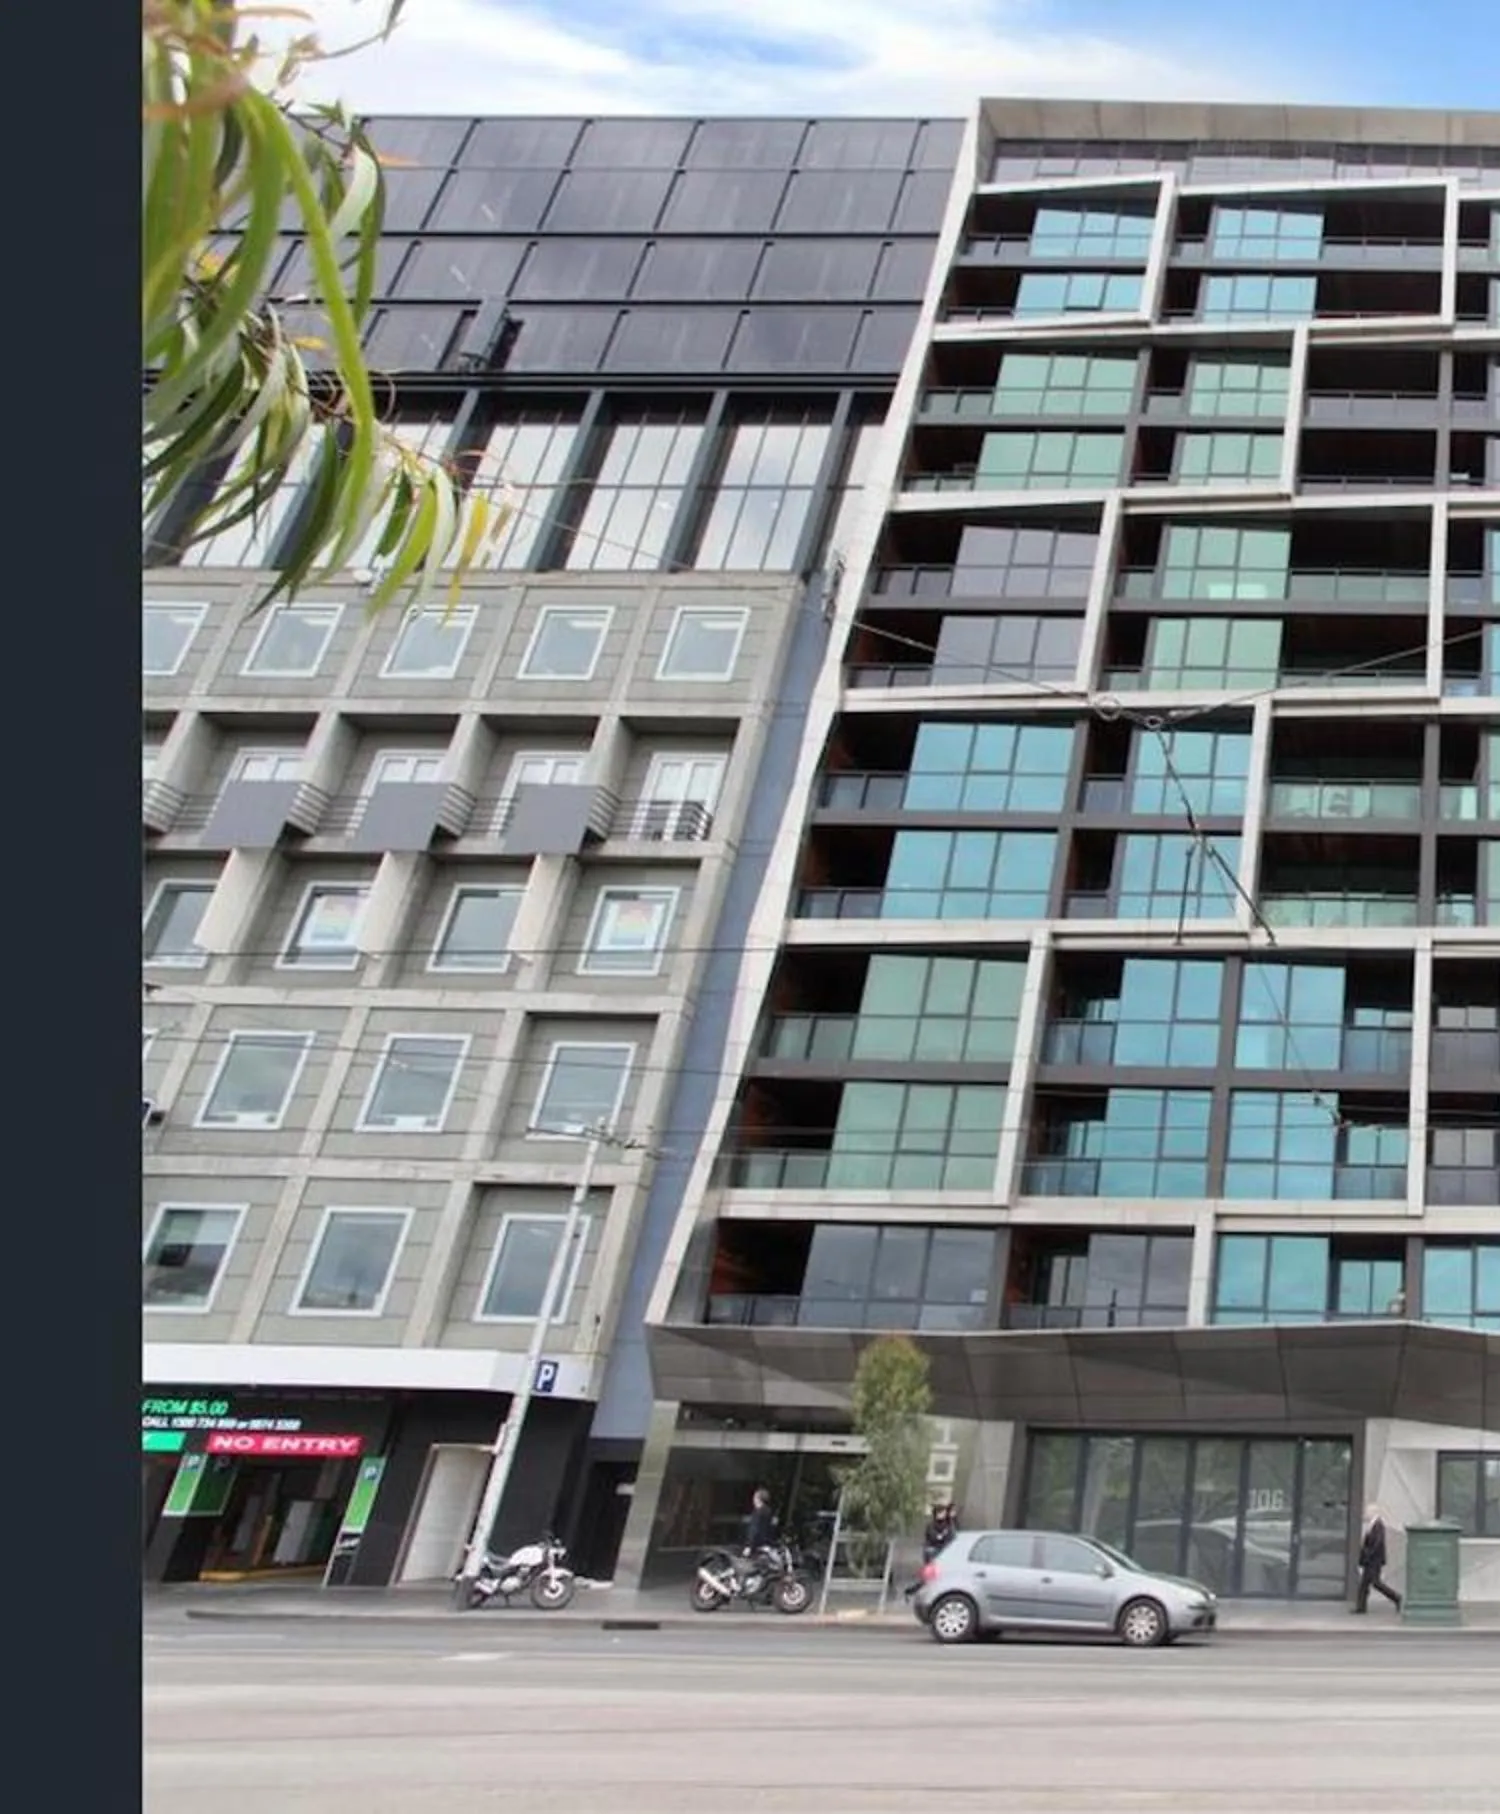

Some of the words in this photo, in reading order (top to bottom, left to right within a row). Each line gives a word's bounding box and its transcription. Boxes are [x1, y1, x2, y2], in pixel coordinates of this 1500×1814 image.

[536, 1363, 555, 1390] P
[142, 1400, 189, 1414] FROM
[142, 1415, 169, 1428] CALL
[213, 1435, 256, 1450] NO
[262, 1436, 362, 1451] ENTRY
[1249, 1488, 1284, 1512] 106
